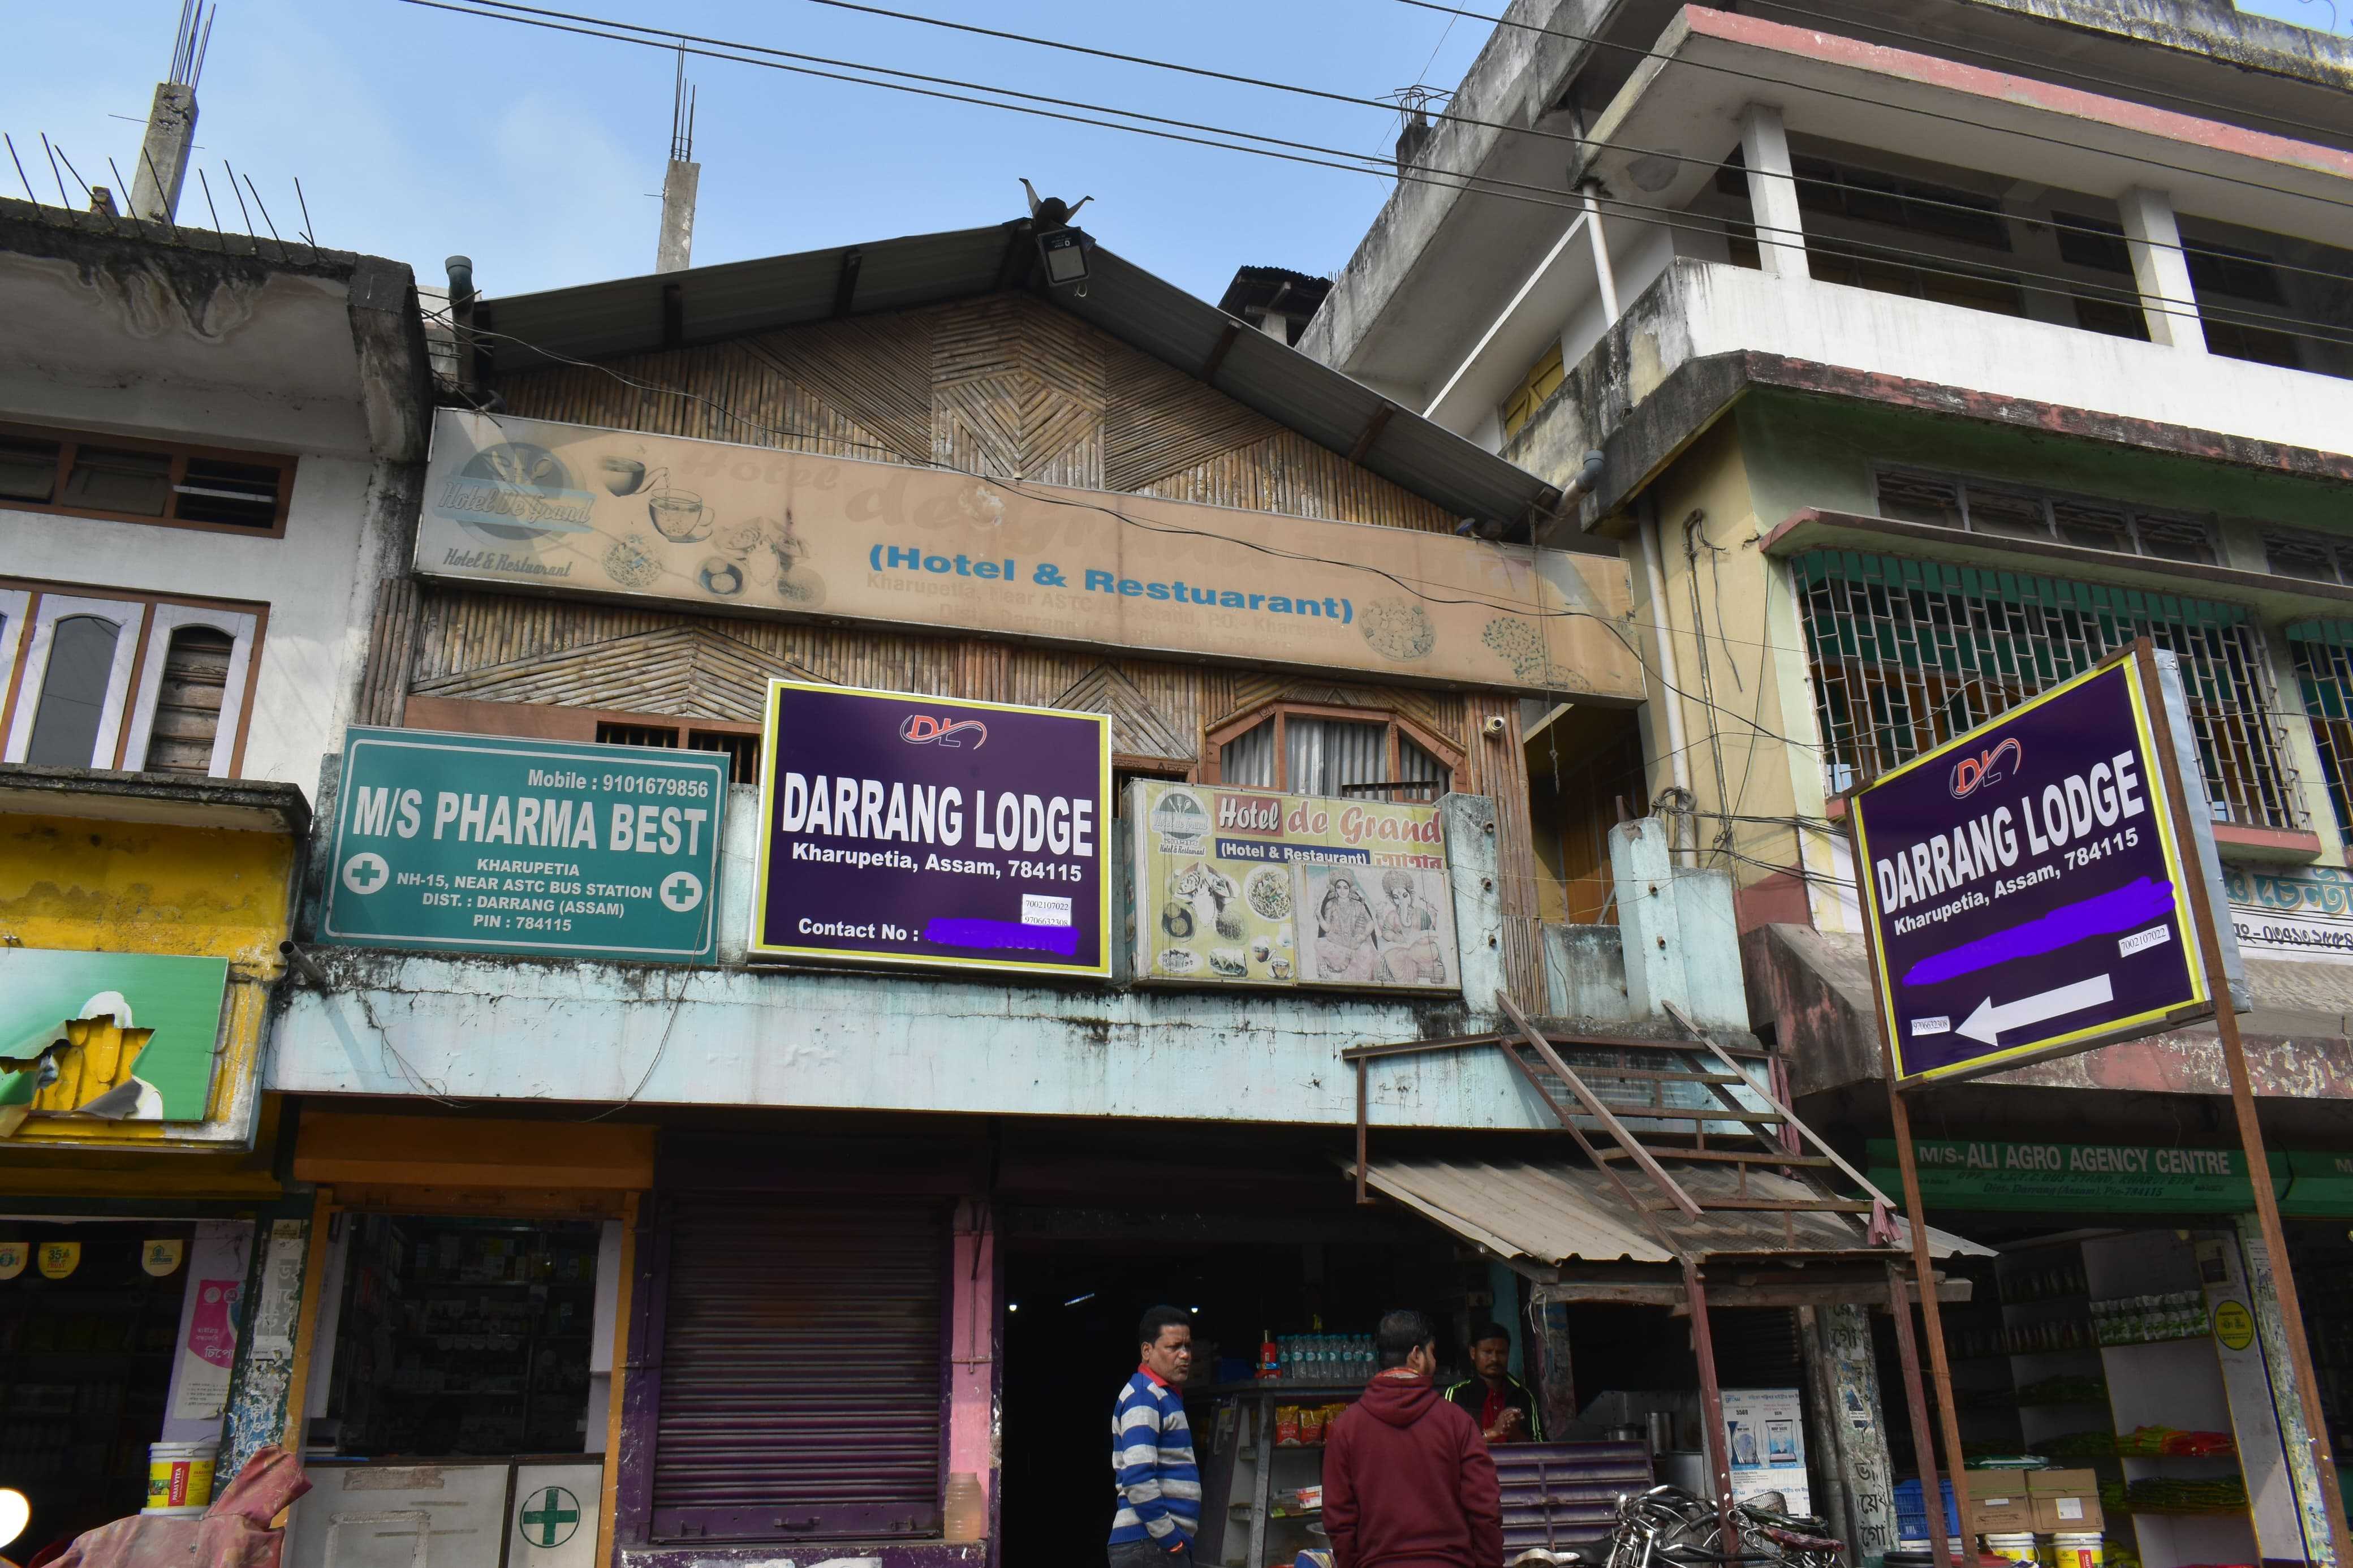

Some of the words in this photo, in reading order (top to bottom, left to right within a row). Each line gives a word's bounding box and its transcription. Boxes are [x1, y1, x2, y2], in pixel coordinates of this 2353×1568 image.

[439, 483, 498, 513] Hotel
[528, 494, 593, 524] Grand
[443, 548, 485, 568] Hotel
[483, 553, 496, 569] &
[869, 544, 1015, 581] (Hotel
[1033, 563, 1067, 587] &
[1084, 569, 1353, 624] Restuarant)
[529, 769, 587, 789] Mobile
[592, 775, 598, 790] :
[604, 774, 709, 798] 9101679856
[353, 785, 423, 839] M/S
[433, 792, 597, 850] PHARMA
[610, 803, 708, 856] BEST
[783, 772, 962, 846] DARRANG
[976, 790, 1093, 857] LODGE
[1219, 797, 1278, 830] Hotel
[1288, 800, 1328, 834] de
[1339, 805, 1442, 845] Grand
[1877, 806, 2019, 915] DARRANG
[2022, 749, 2144, 856] LODGE
[1160, 843, 1173, 853] Hotel
[1222, 843, 1264, 857] (Hotel
[1269, 846, 1280, 858] &
[1284, 848, 1366, 864] Restaurant)
[477, 859, 580, 876] KHARUPETIA
[792, 843, 919, 873] Kharupetia,
[925, 854, 1001, 880] Assam,
[1008, 860, 1081, 882] 784115
[397, 872, 449, 890] NH-15,
[455, 876, 498, 890] NEAR
[502, 878, 545, 893] ASTC
[549, 881, 582, 895] BUS
[586, 883, 652, 899] STATION
[1894, 890, 1990, 935] Kharupetia,
[1994, 865, 2061, 899] Assam,
[2064, 827, 2139, 870] 784115
[422, 893, 462, 907] DIST.
[476, 897, 554, 913] DARRANG
[559, 901, 625, 918] (ASSAM)
[1025, 901, 1068, 911] 7002107022
[473, 914, 501, 928] PIN
[515, 916, 571, 932] 784115
[798, 918, 875, 939] Contact
[881, 924, 907, 940] No
[1025, 916, 1068, 927] 9706632308
[2121, 928, 2166, 950] 7002107022
[2005, 1145, 2061, 1169] AGRO
[2070, 1148, 2148, 1173] AGENCY
[2156, 1149, 2231, 1174] CENTRE
